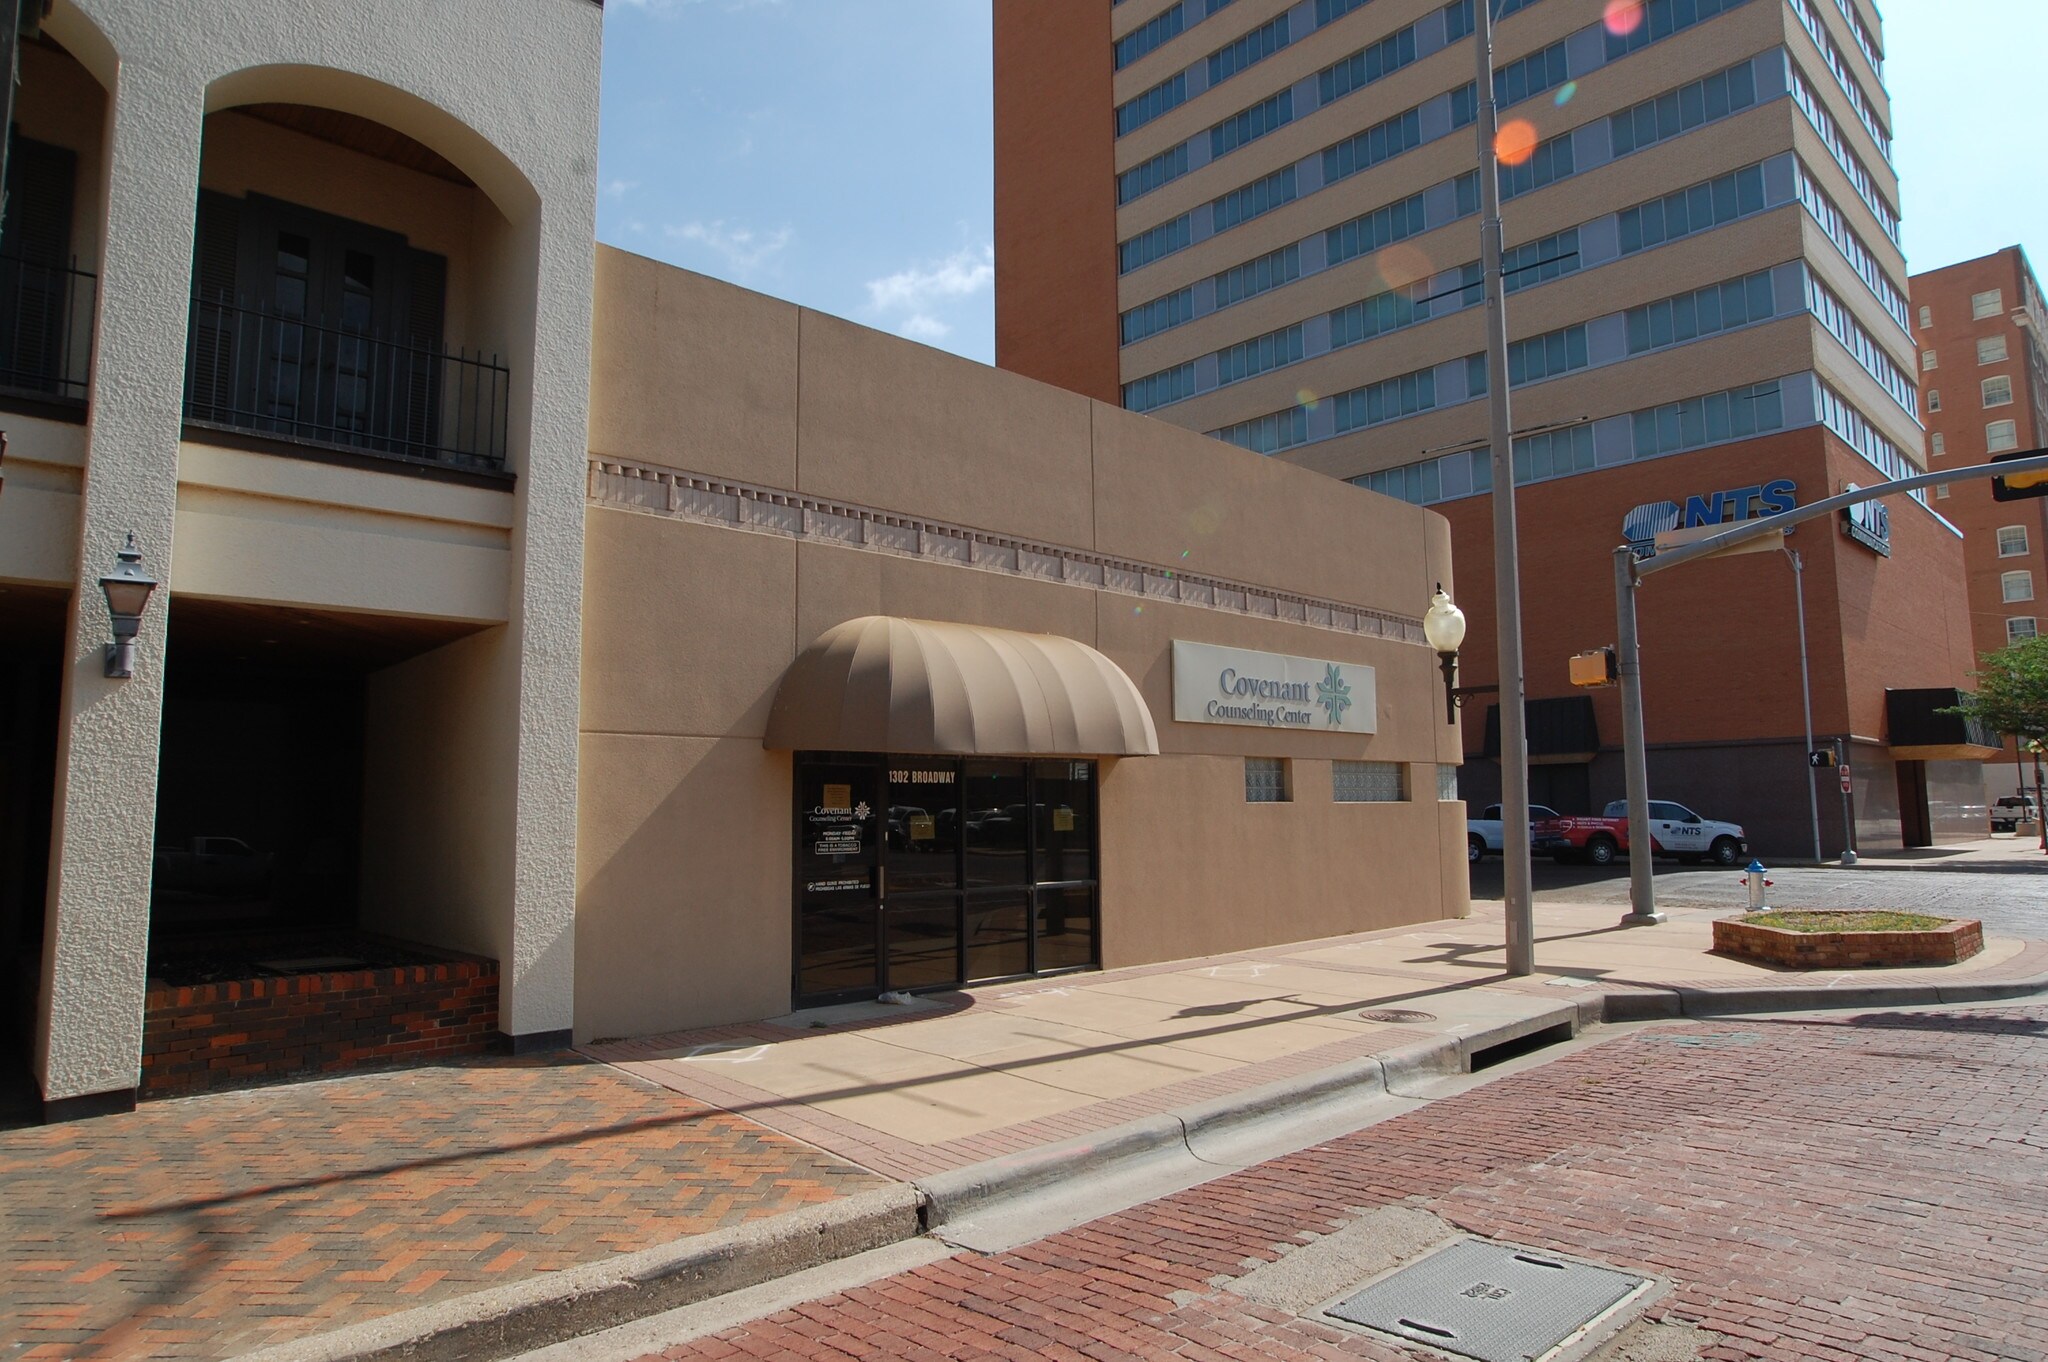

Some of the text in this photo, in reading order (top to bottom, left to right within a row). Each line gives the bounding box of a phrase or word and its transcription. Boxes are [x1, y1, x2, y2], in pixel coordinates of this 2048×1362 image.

[1685, 479, 1796, 528] NTS
[1220, 667, 1311, 703] Covenant
[1207, 699, 1312, 726] Counseling Center
[888, 770, 956, 784] 1302 BROADWAY
[814, 805, 852, 815] Covenant
[1681, 826, 1702, 836] NTS
